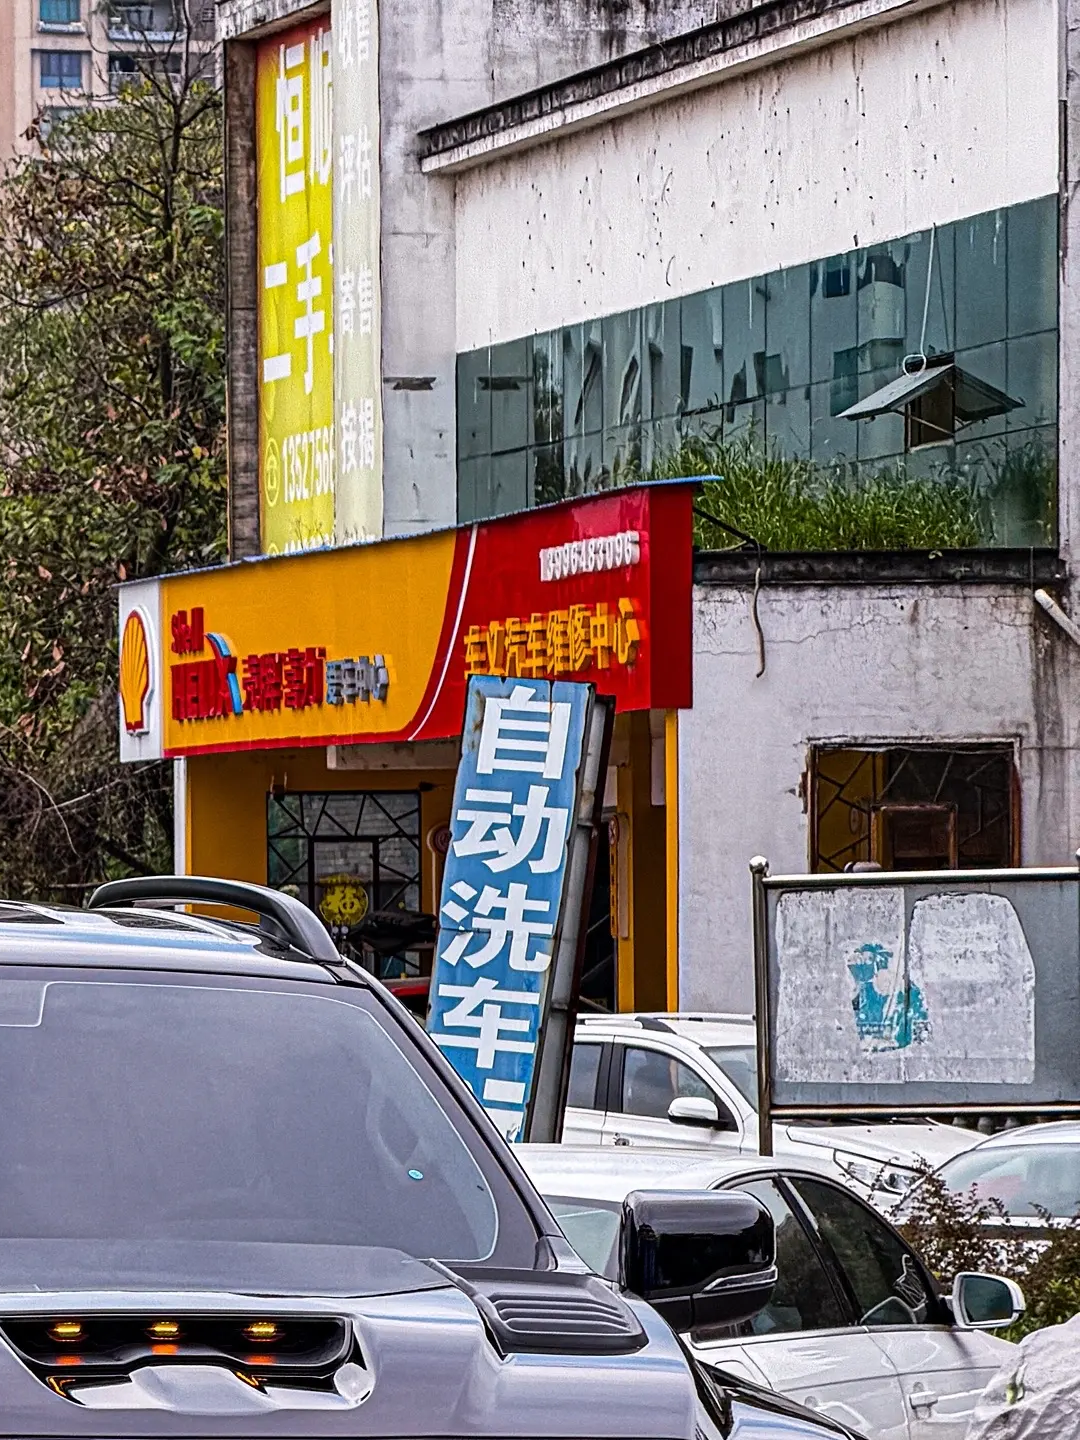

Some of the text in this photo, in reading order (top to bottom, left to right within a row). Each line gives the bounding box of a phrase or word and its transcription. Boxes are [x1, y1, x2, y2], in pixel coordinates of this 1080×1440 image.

[339, 124, 372, 204] 评估
[263, 231, 333, 394] 二手
[539, 531, 640, 582] 13996483096
